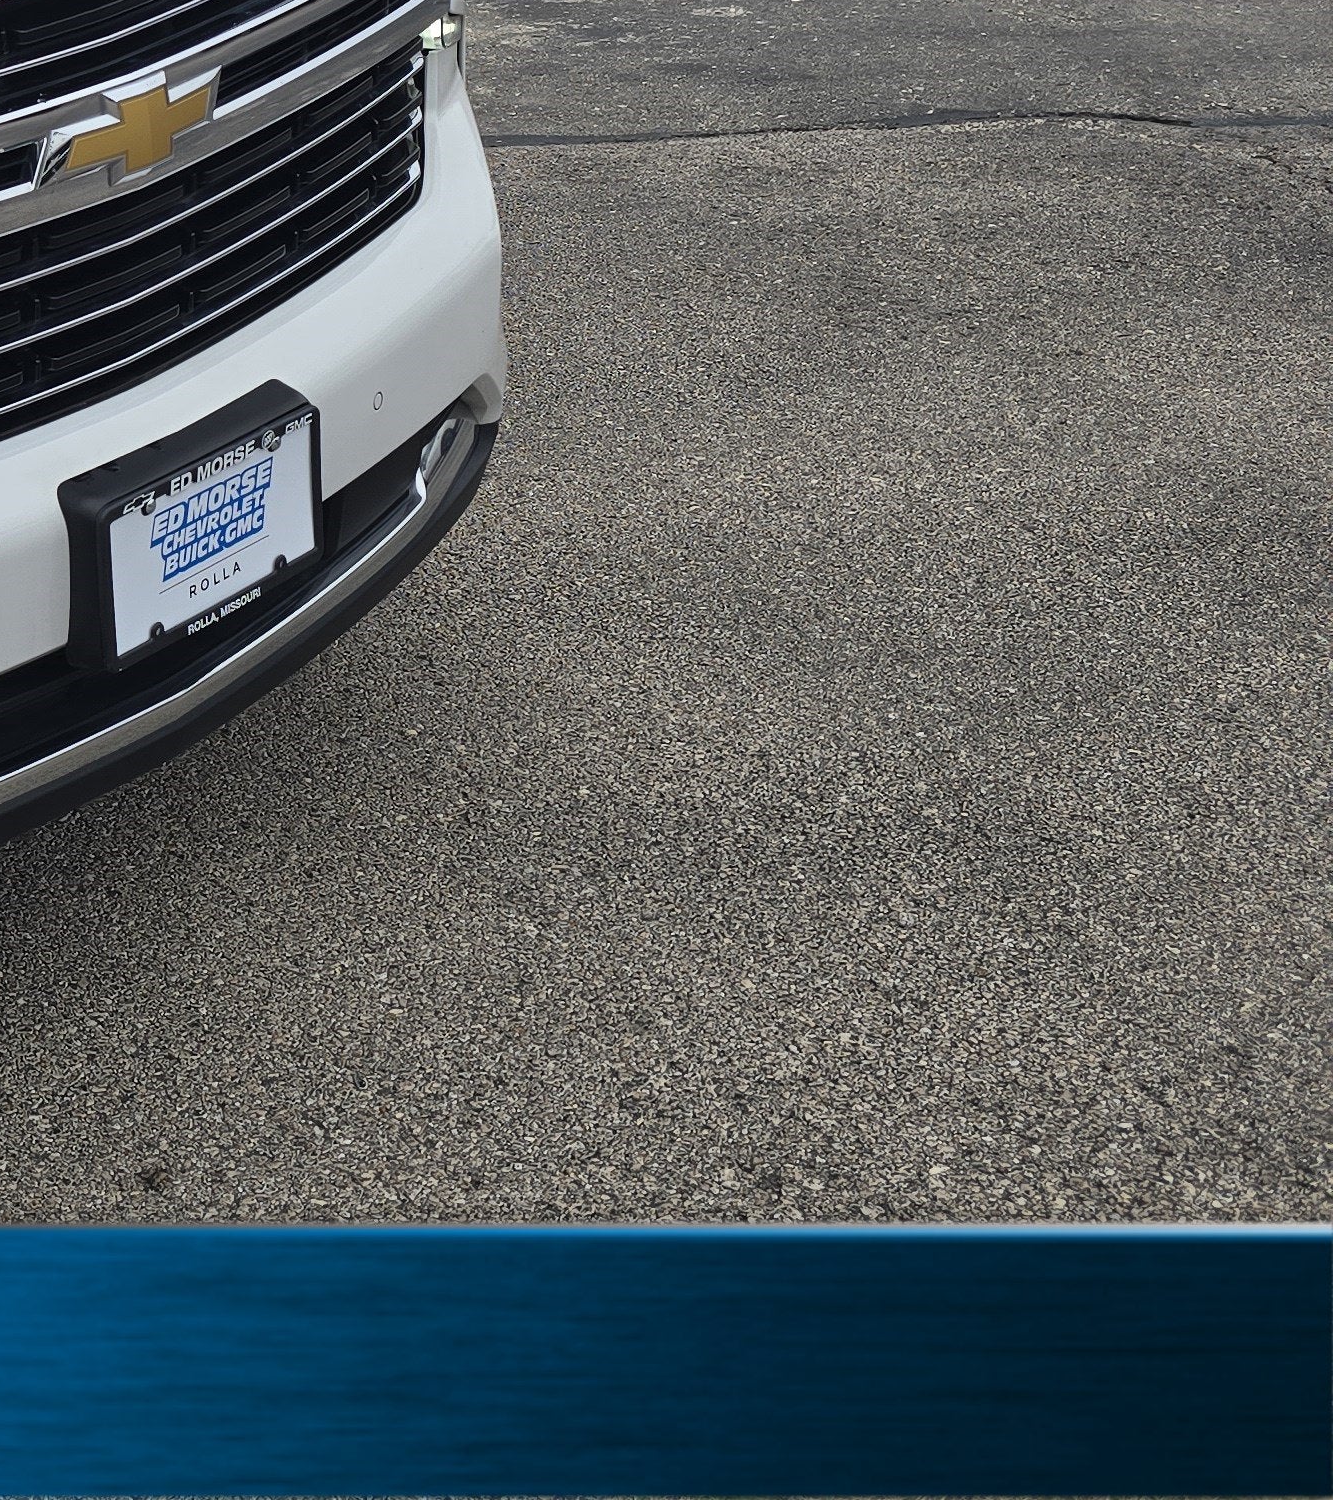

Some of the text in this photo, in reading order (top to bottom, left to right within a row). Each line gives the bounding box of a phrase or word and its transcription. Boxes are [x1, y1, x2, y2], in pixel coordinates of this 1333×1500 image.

[170, 412, 313, 497] ED MORSE GMC
[150, 459, 273, 543] ED MORSE
[162, 489, 265, 556] CHEVROLET
[187, 586, 262, 636] ROLLA, MISSOURI
[189, 561, 242, 598] ROLLA
